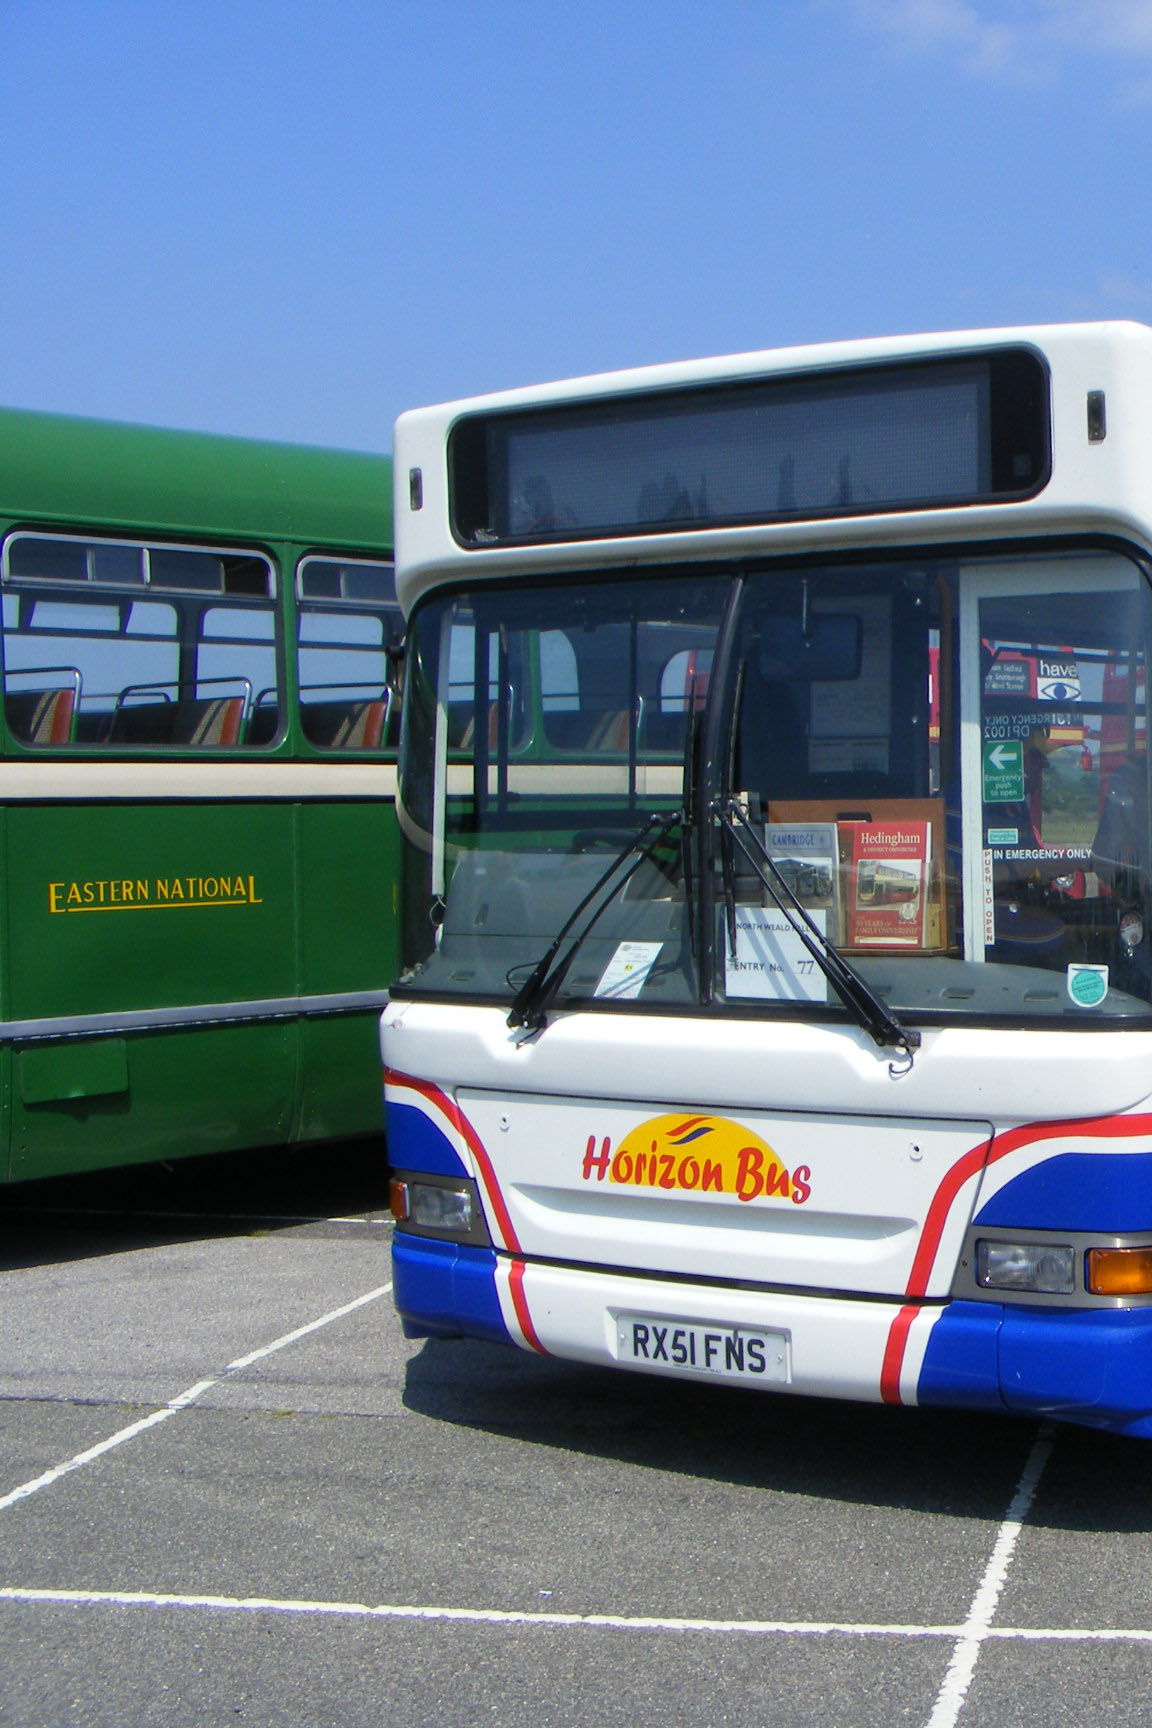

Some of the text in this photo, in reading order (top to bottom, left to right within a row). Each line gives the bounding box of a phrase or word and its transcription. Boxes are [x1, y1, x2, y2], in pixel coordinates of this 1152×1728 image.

[1040, 660, 1078, 677] have
[984, 774, 1022, 783] Emergency
[995, 782, 1012, 791] push
[1000, 790, 1018, 798] open
[772, 834, 814, 846] CAMBRIDGE
[860, 831, 920, 846] Hedingham
[993, 848, 1092, 860] IN EMERGENCY ONLY
[49, 875, 263, 913] EASTERN NATIONAL
[984, 851, 993, 942] PUSH TO OPEN
[736, 922, 762, 930] NORTH
[764, 923, 791, 932] WEALD
[734, 960, 815, 975] ENTRY No. 77
[582, 1135, 812, 1204] Horizon Bus
[633, 1323, 766, 1374] RX51 FNS
